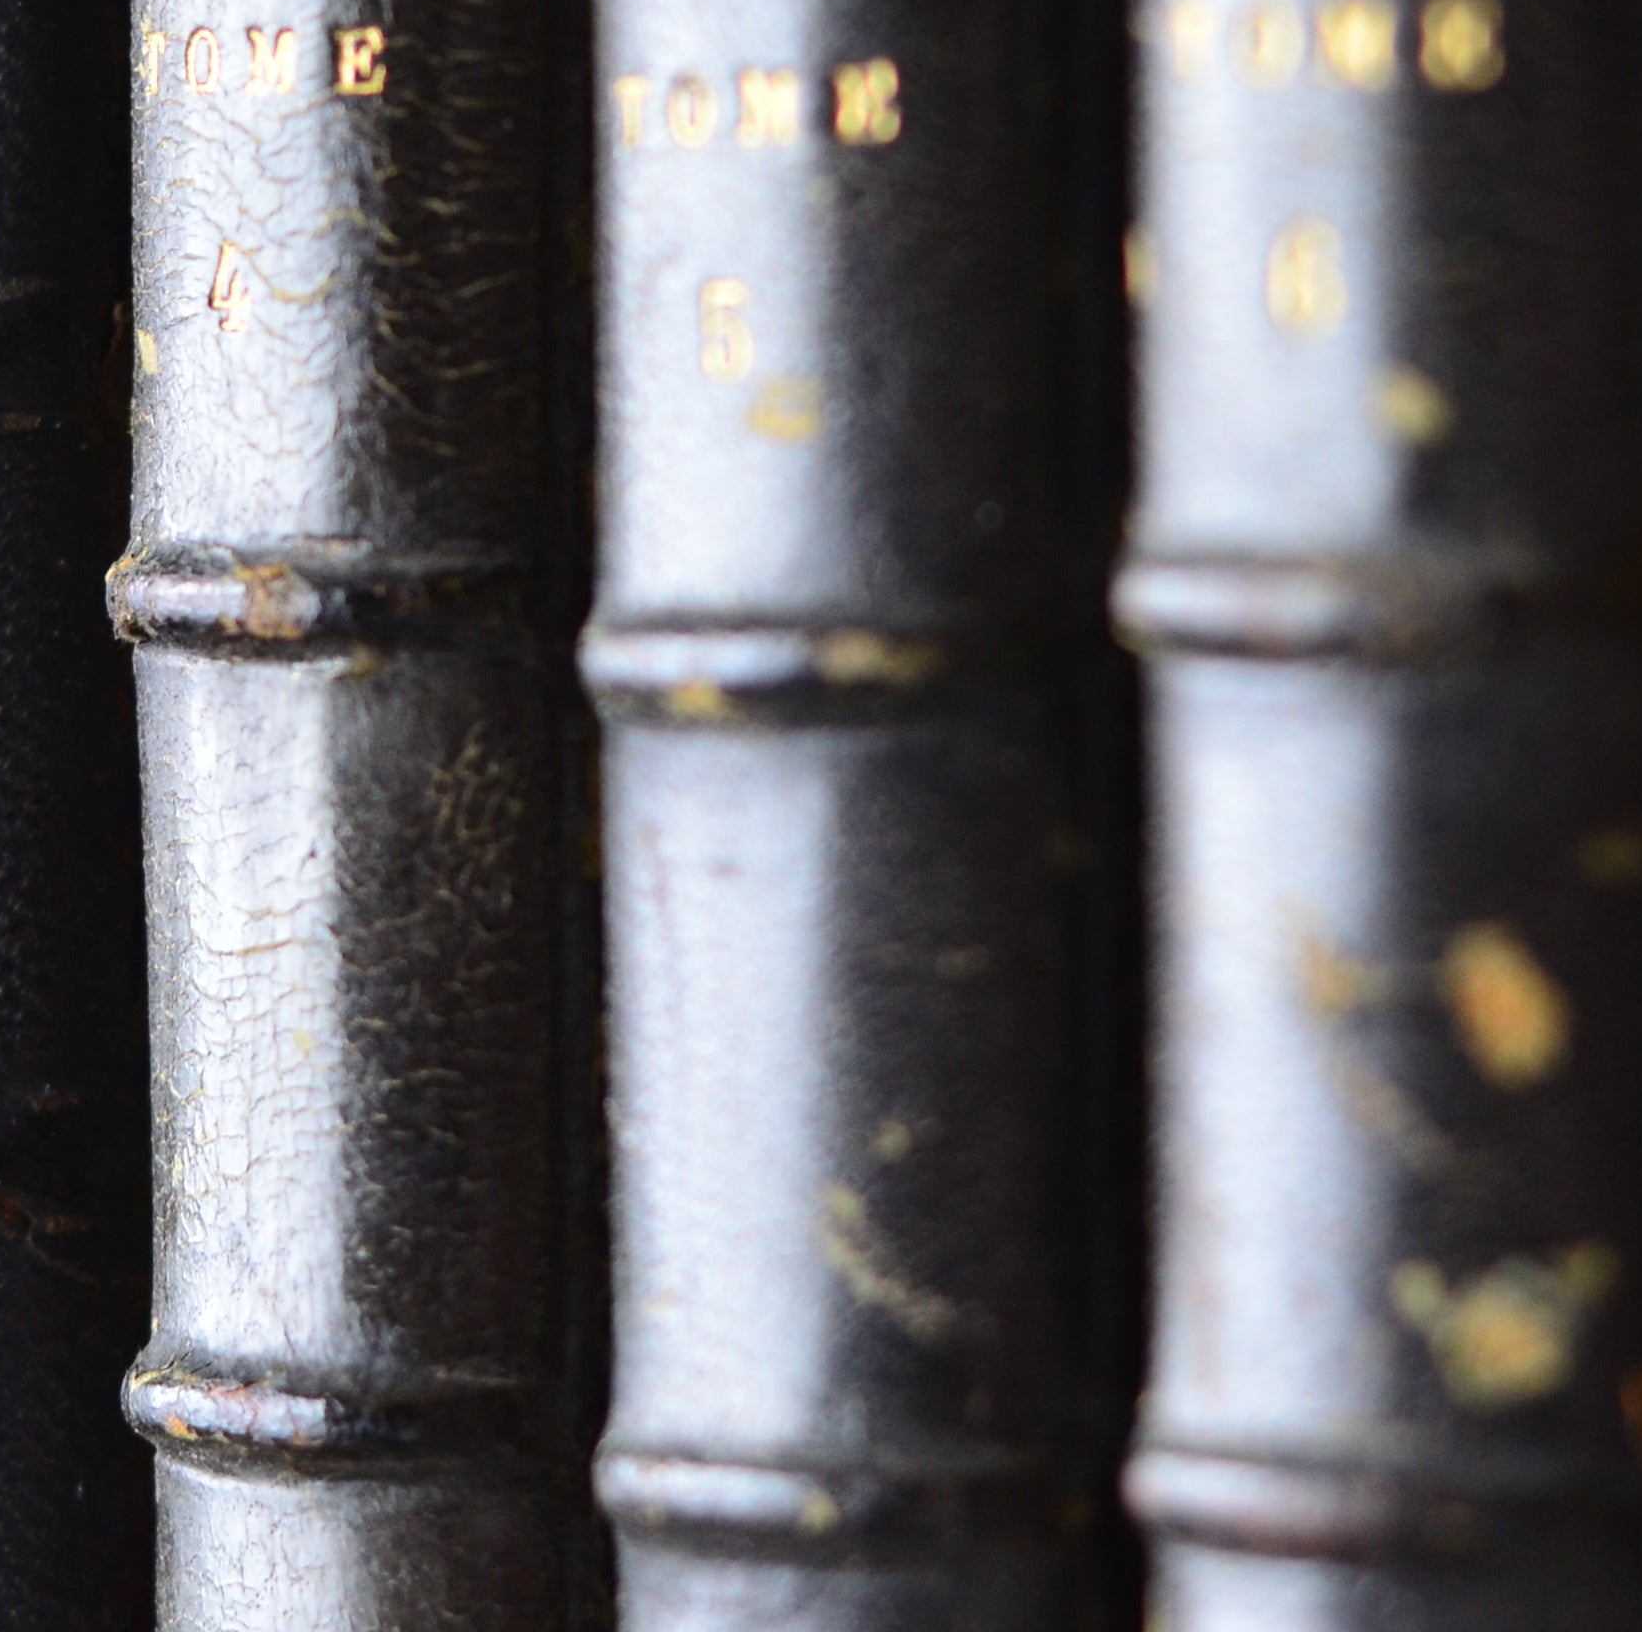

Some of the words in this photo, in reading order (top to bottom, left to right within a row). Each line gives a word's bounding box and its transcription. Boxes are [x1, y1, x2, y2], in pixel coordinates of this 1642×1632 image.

[142, 24, 388, 96] TOME
[612, 56, 903, 149] TOME
[207, 238, 253, 333] 4
[697, 276, 754, 388] 5
